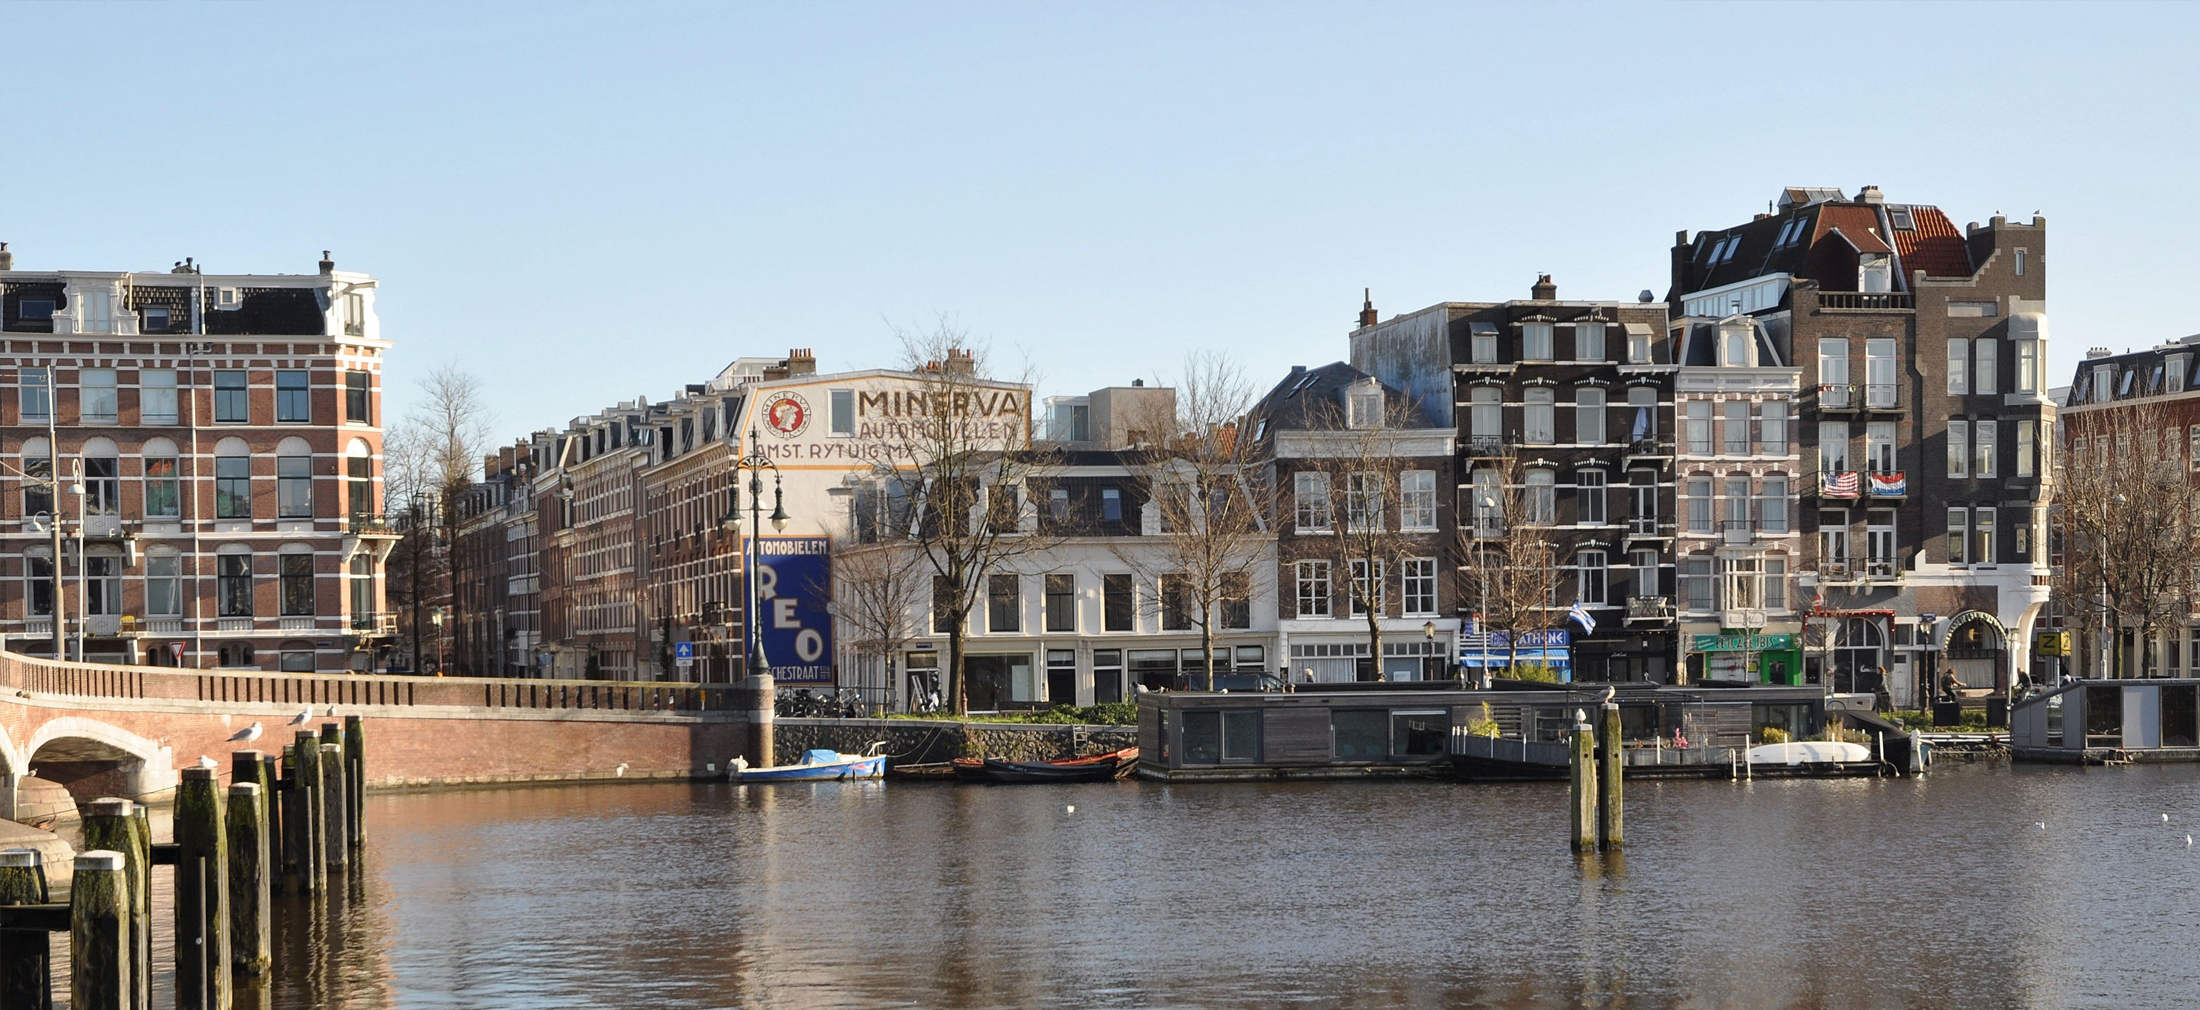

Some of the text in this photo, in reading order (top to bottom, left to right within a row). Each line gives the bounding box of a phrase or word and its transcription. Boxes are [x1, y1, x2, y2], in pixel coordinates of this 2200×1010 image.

[763, 392, 809, 413] MINERVA
[859, 391, 1018, 417] MINERVA
[755, 444, 804, 459] AMST.
[809, 444, 880, 459] RYTUIG
[746, 541, 827, 556] ATOMOBIELEN
[750, 564, 824, 663] REO
